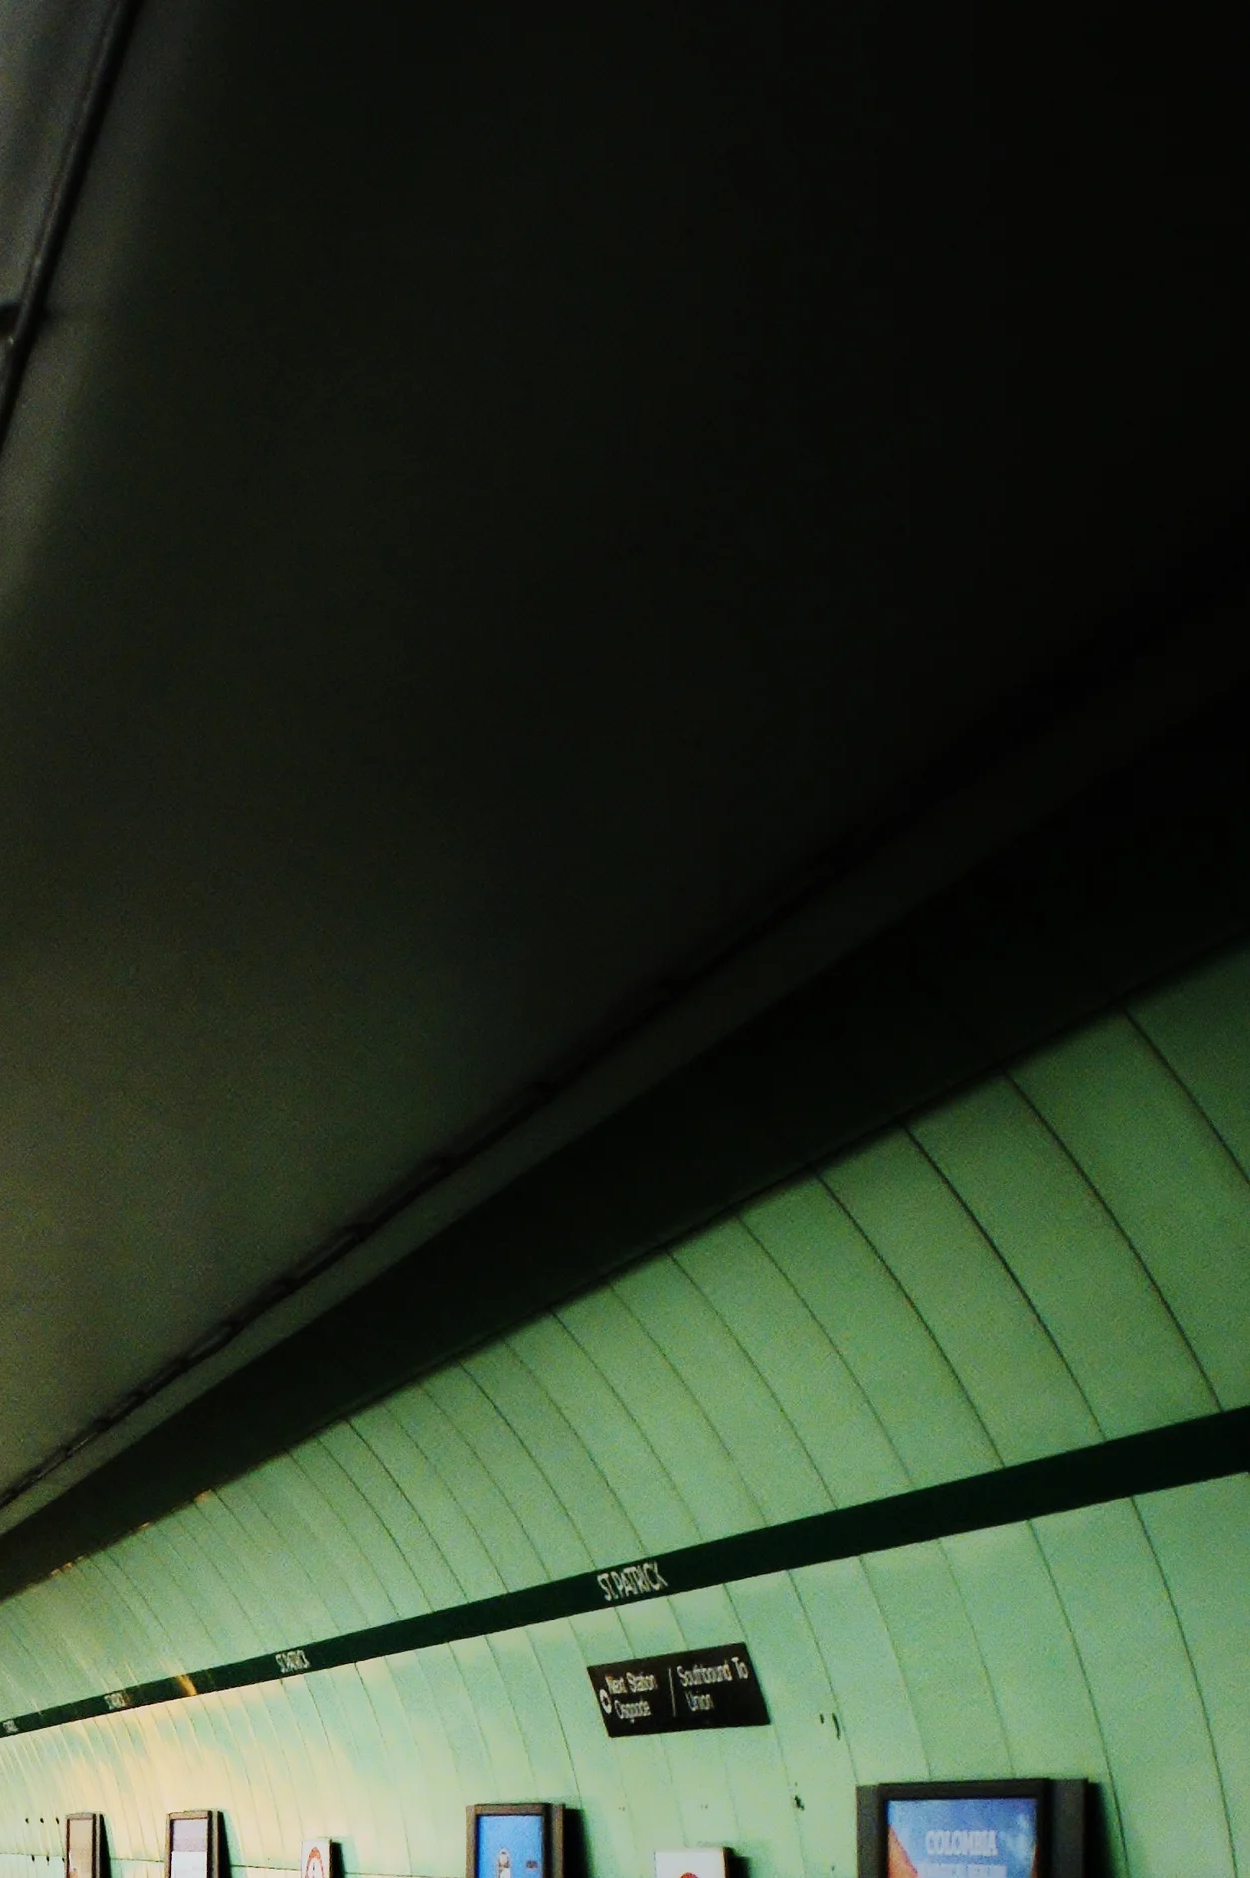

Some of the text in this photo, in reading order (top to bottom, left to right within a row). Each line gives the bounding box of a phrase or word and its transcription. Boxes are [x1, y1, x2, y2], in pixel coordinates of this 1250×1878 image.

[611, 1561, 669, 1599] PATRICK
[626, 1670, 659, 1693] Station
[676, 1655, 750, 1688] Southbound To
[684, 1690, 715, 1712] Union
[925, 1830, 999, 1857] COLOMBIA
